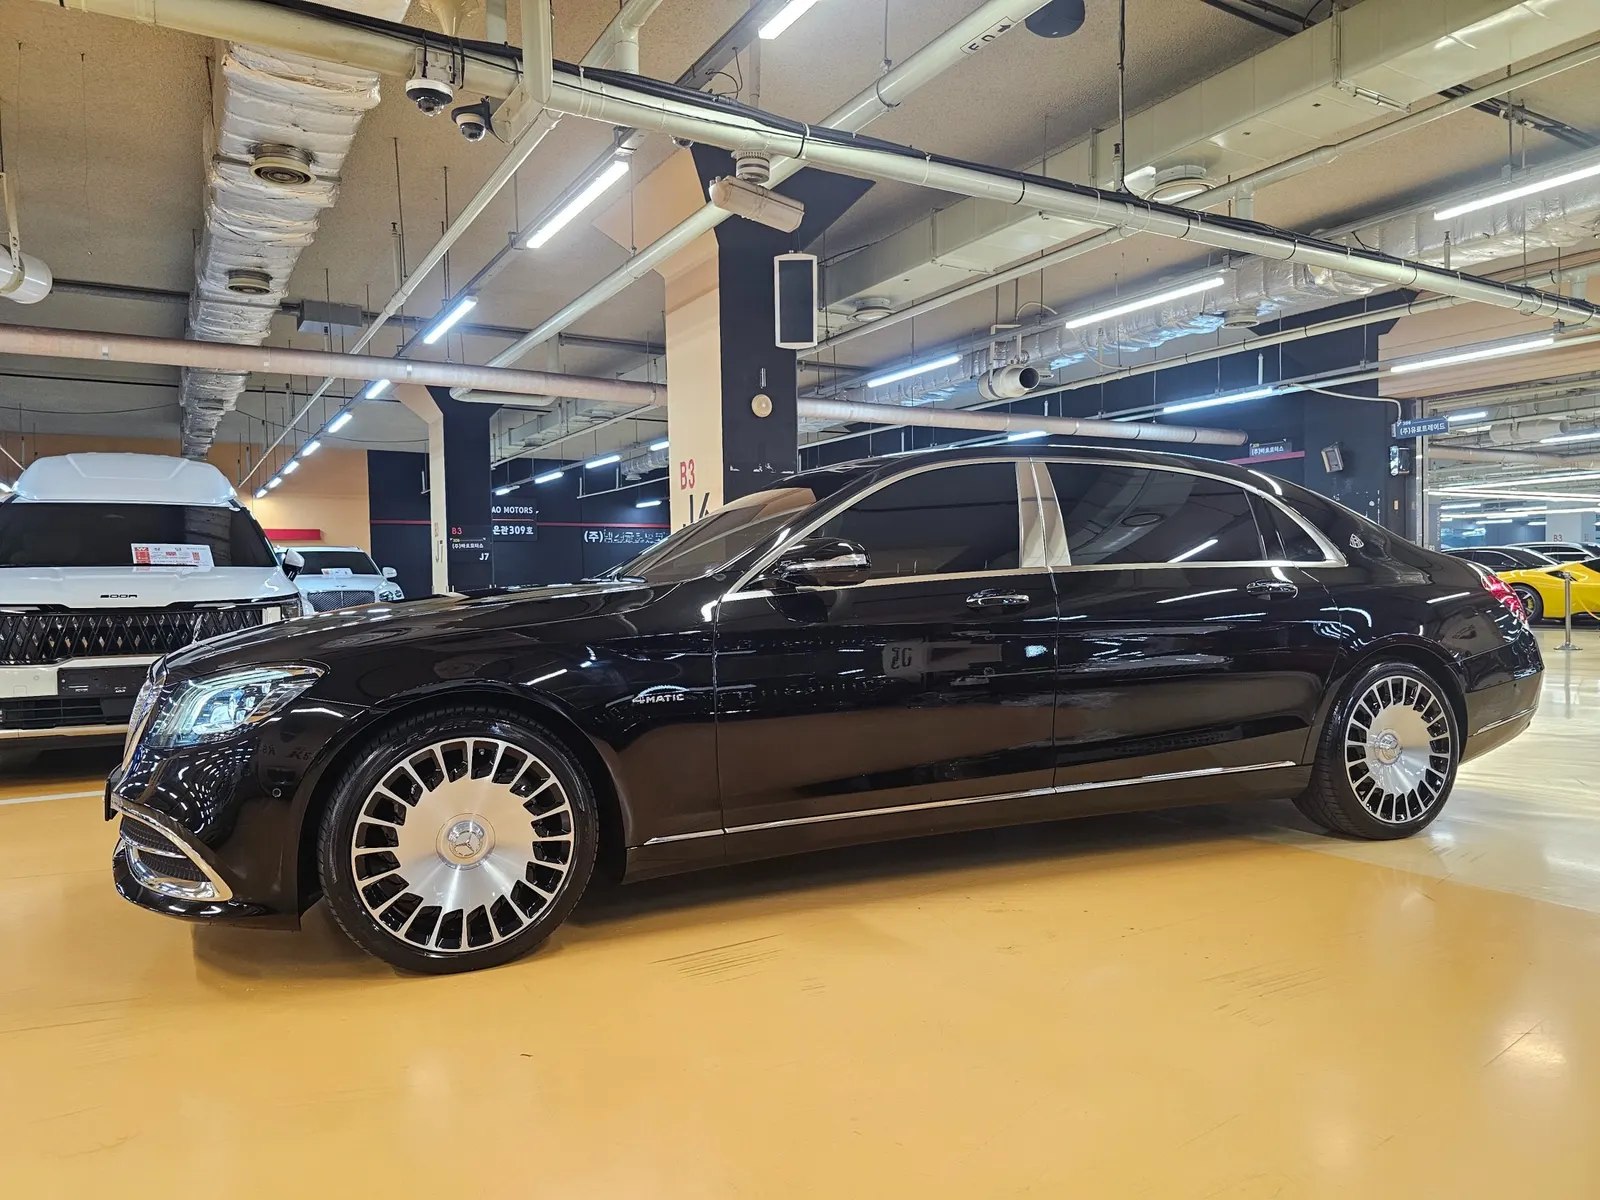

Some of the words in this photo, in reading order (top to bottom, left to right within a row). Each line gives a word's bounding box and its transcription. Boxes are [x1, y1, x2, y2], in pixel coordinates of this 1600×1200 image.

[680, 458, 696, 491] B3
[503, 506, 534, 514] MOTORS
[451, 527, 463, 535] B3
[1553, 534, 1563, 543] B3
[479, 552, 490, 561] J7
[632, 693, 685, 704] 4MATIC
